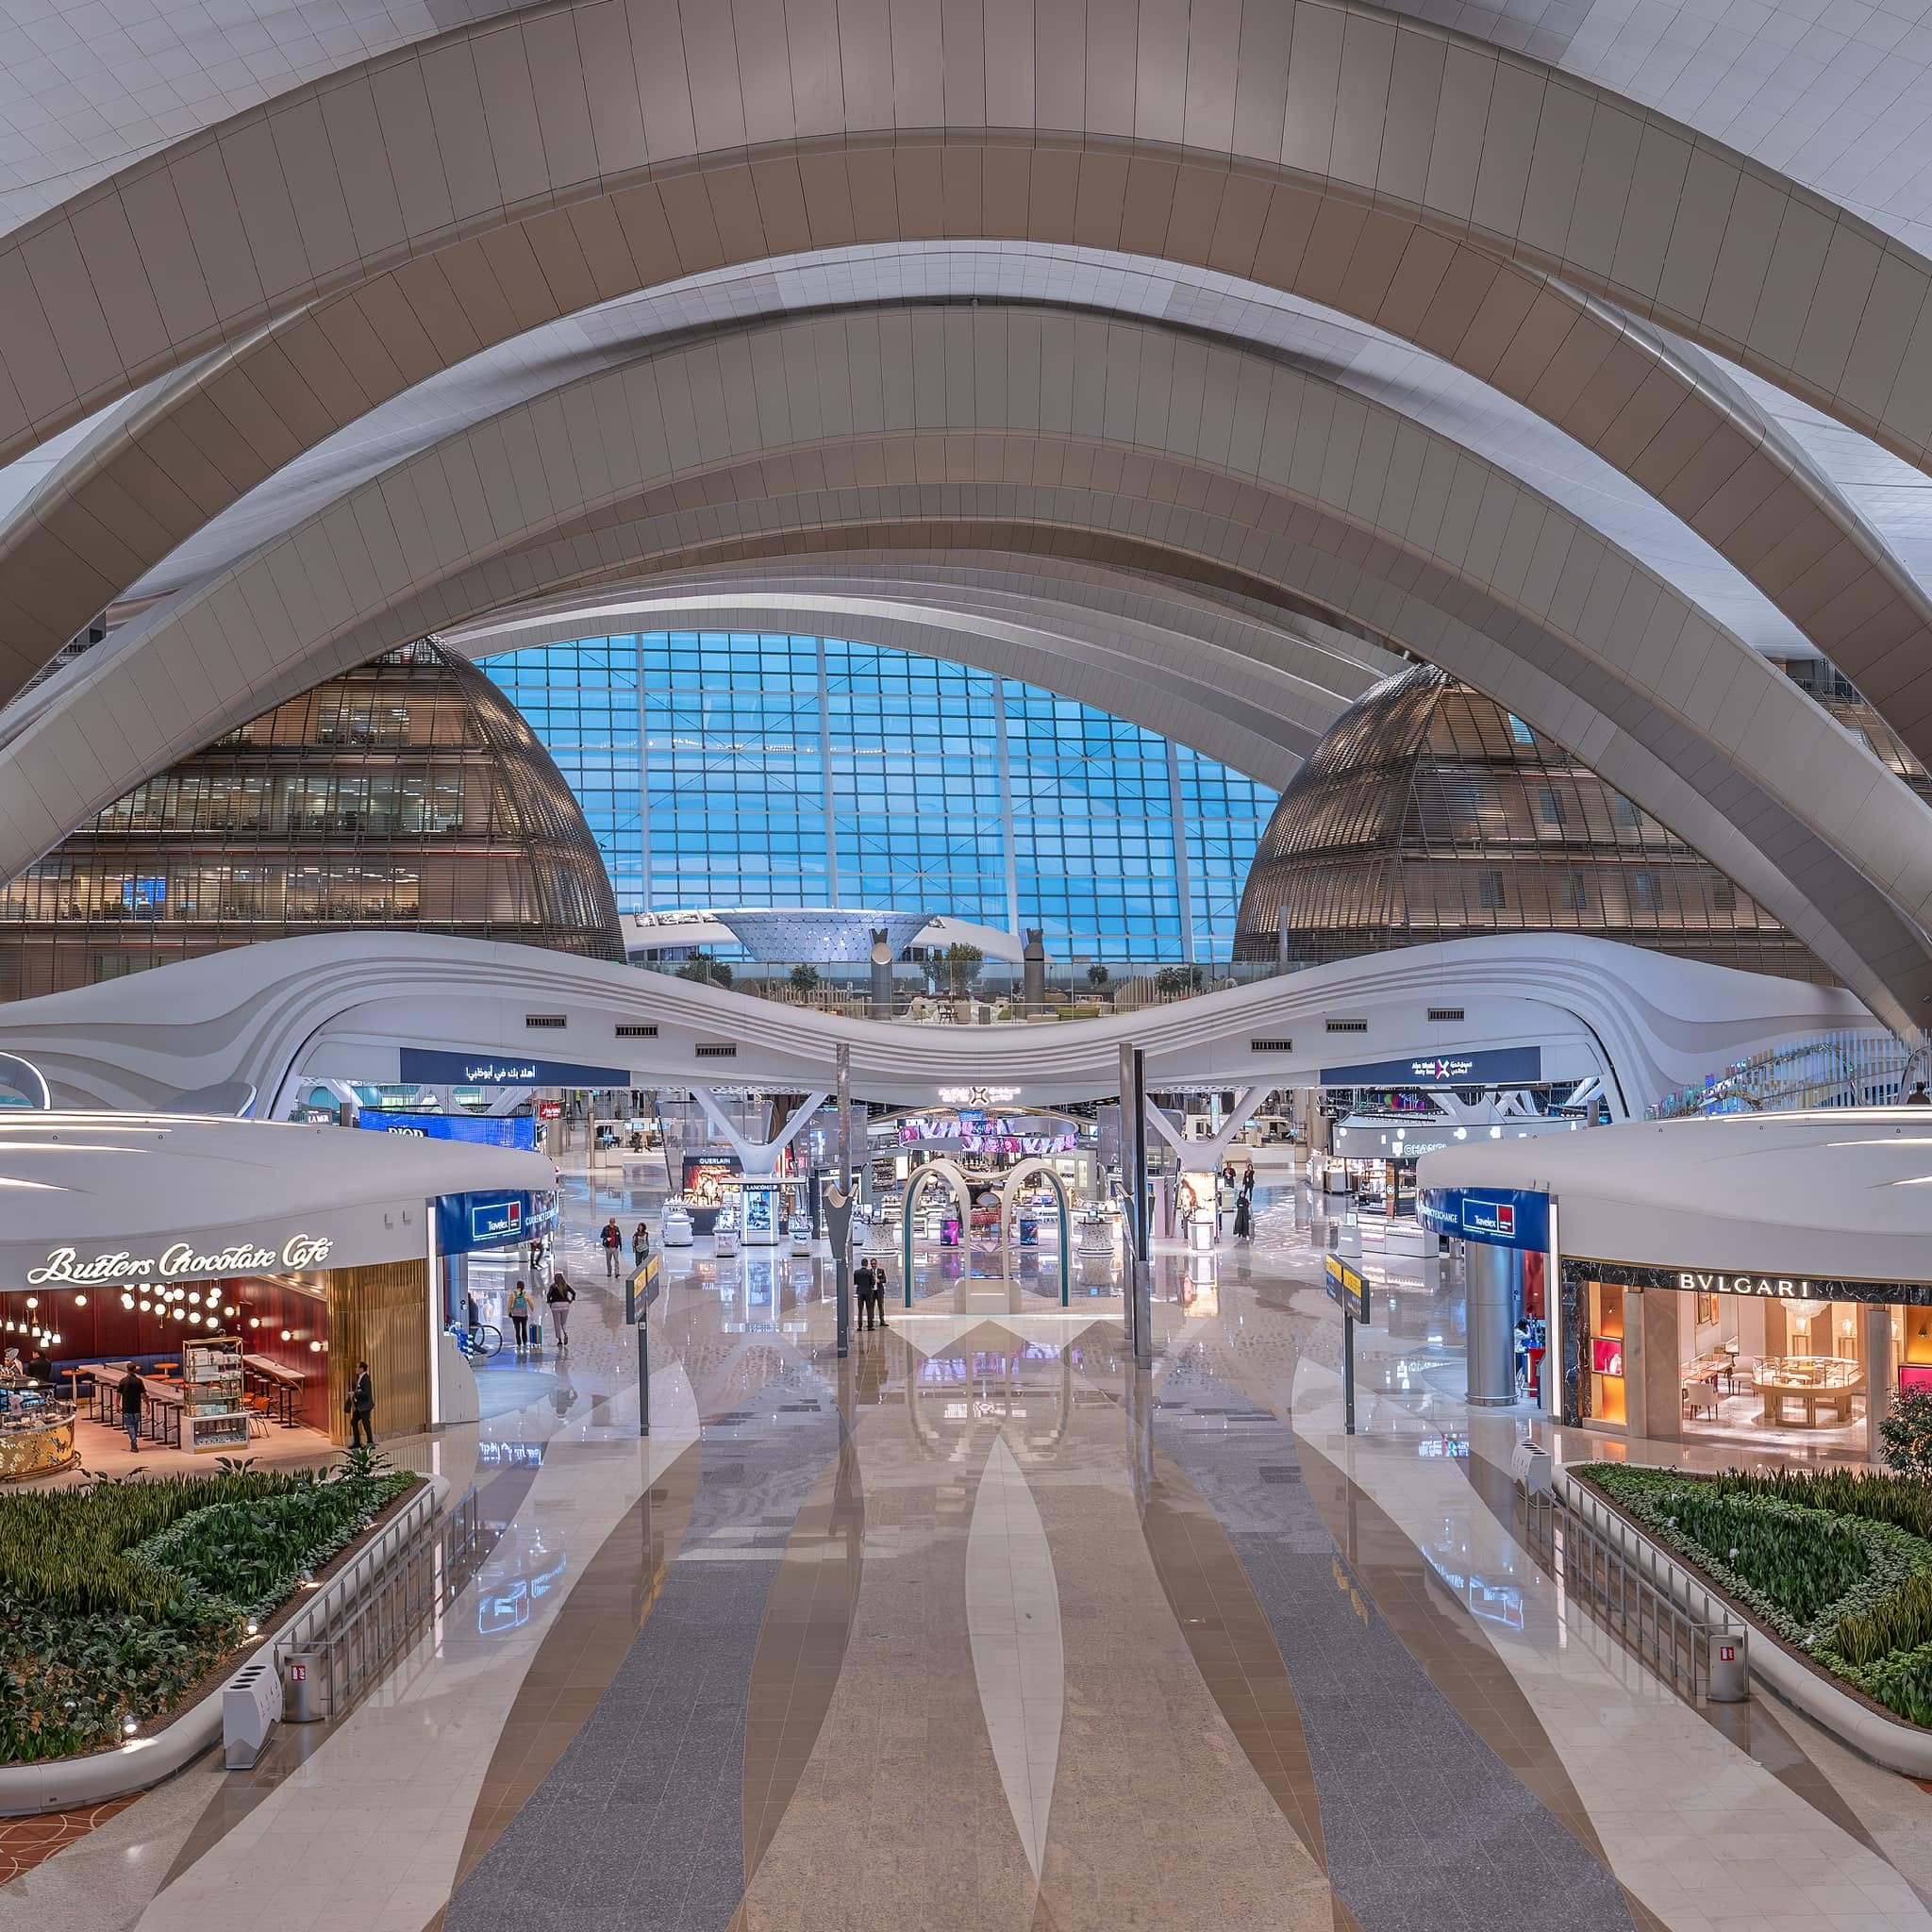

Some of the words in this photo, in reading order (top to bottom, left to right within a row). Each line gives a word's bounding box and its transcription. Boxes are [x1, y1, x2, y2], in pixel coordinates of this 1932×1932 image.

[27, 1247, 156, 1285] Butlers
[158, 1242, 276, 1276] Chocolate
[282, 1233, 334, 1270] Café
[1679, 1273, 1809, 1298] BVLGARI
